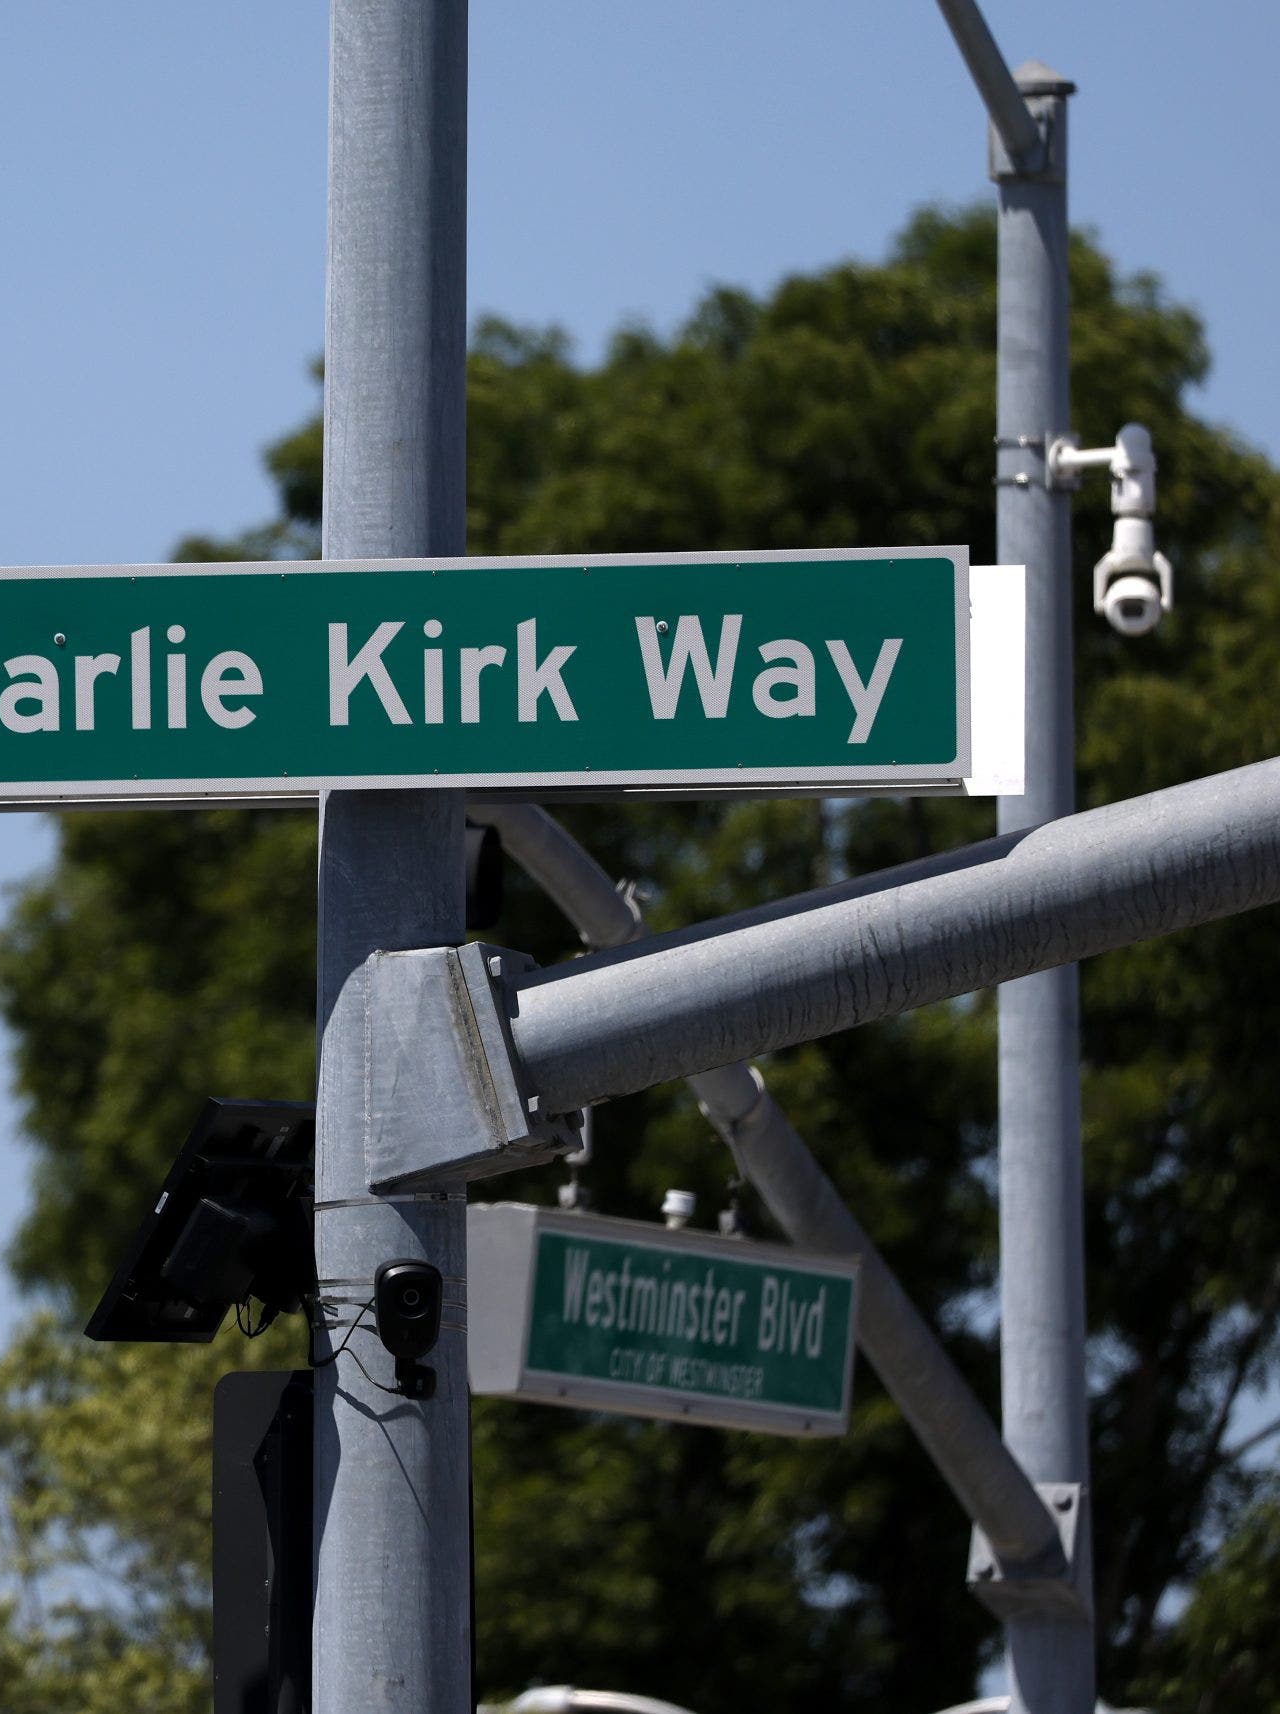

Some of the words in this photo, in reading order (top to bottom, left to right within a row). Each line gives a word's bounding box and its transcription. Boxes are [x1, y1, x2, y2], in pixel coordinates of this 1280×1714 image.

[328, 617, 579, 726] Kirk
[635, 615, 904, 743] Way
[564, 1247, 746, 1346] Westminster
[758, 1277, 826, 1358] Blvd
[610, 1348, 644, 1379] CITY
[646, 1352, 667, 1382] OF
[670, 1356, 763, 1397] WESTMINSTER
